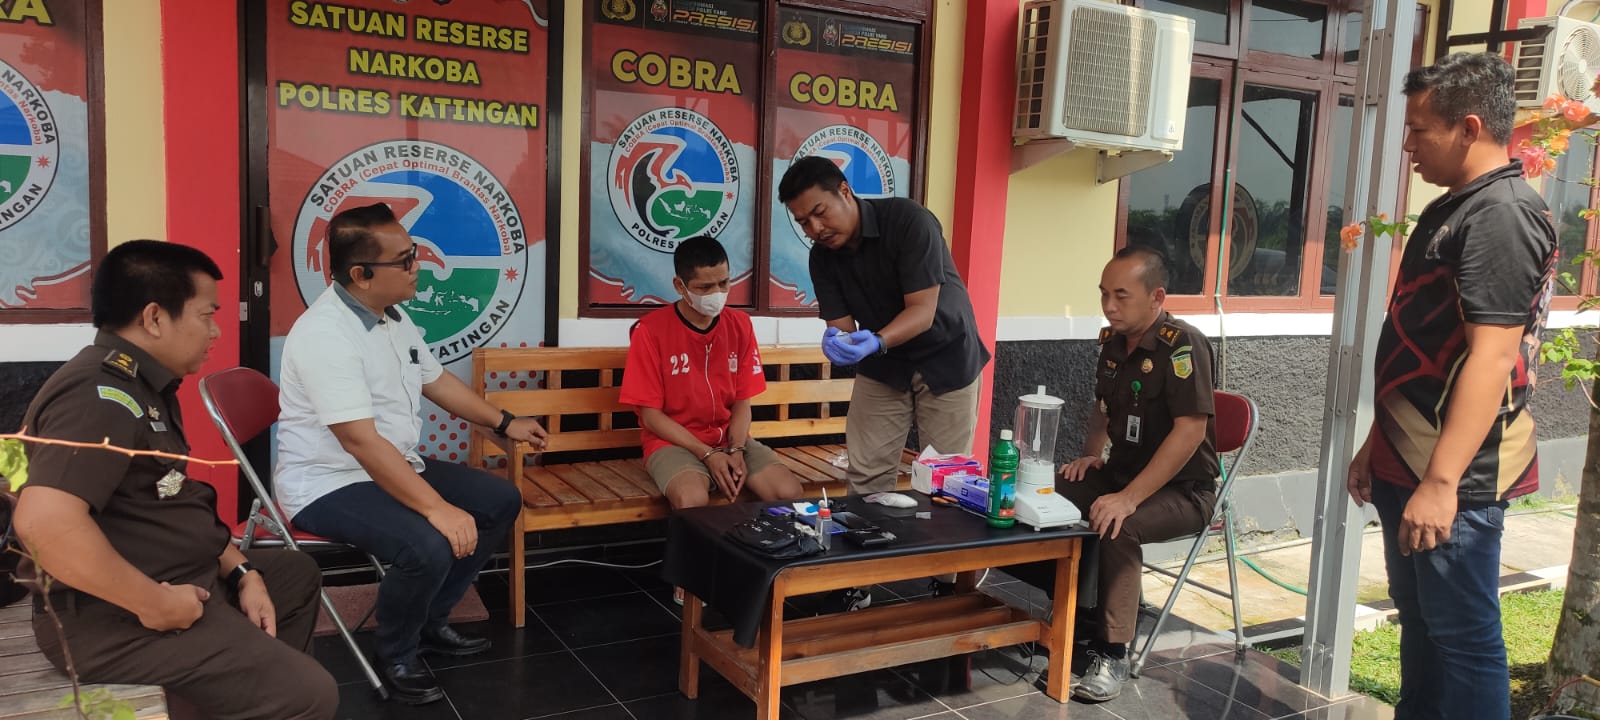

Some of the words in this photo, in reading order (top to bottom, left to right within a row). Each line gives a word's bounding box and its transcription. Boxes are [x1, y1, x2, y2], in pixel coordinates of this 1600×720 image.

[291, 2, 405, 38] SATUAN
[416, 18, 528, 52] RESERSE
[673, 9, 758, 31] PRESISI
[841, 34, 913, 52] PRESISI
[349, 49, 480, 85] NARKOBA
[612, 50, 741, 94] COBRA
[2, 70, 55, 144] NARKOBA
[279, 82, 391, 115] POLRES
[400, 94, 538, 127] KATINGAN
[790, 73, 898, 111] COBRA
[618, 113, 656, 149] SATUAN
[660, 110, 710, 129] RESERSE
[710, 128, 738, 183] NARKOBA
[829, 127, 871, 145] RESERSE
[871, 144, 894, 193] NARKOBA
[0, 183, 42, 225] NGAN
[310, 149, 378, 207] SATUAN
[384, 144, 472, 174] RESERSE
[473, 170, 525, 254] NARKOBA
[323, 178, 358, 213] COBRA
[359, 161, 399, 181] (Cepat
[402, 159, 449, 175] Optimal
[451, 170, 490, 204] Brantas
[489, 204, 512, 256] Narkoba)
[631, 222, 674, 249] POLRES
[430, 299, 510, 359] ATINGAN
[670, 353, 690, 376] 22
